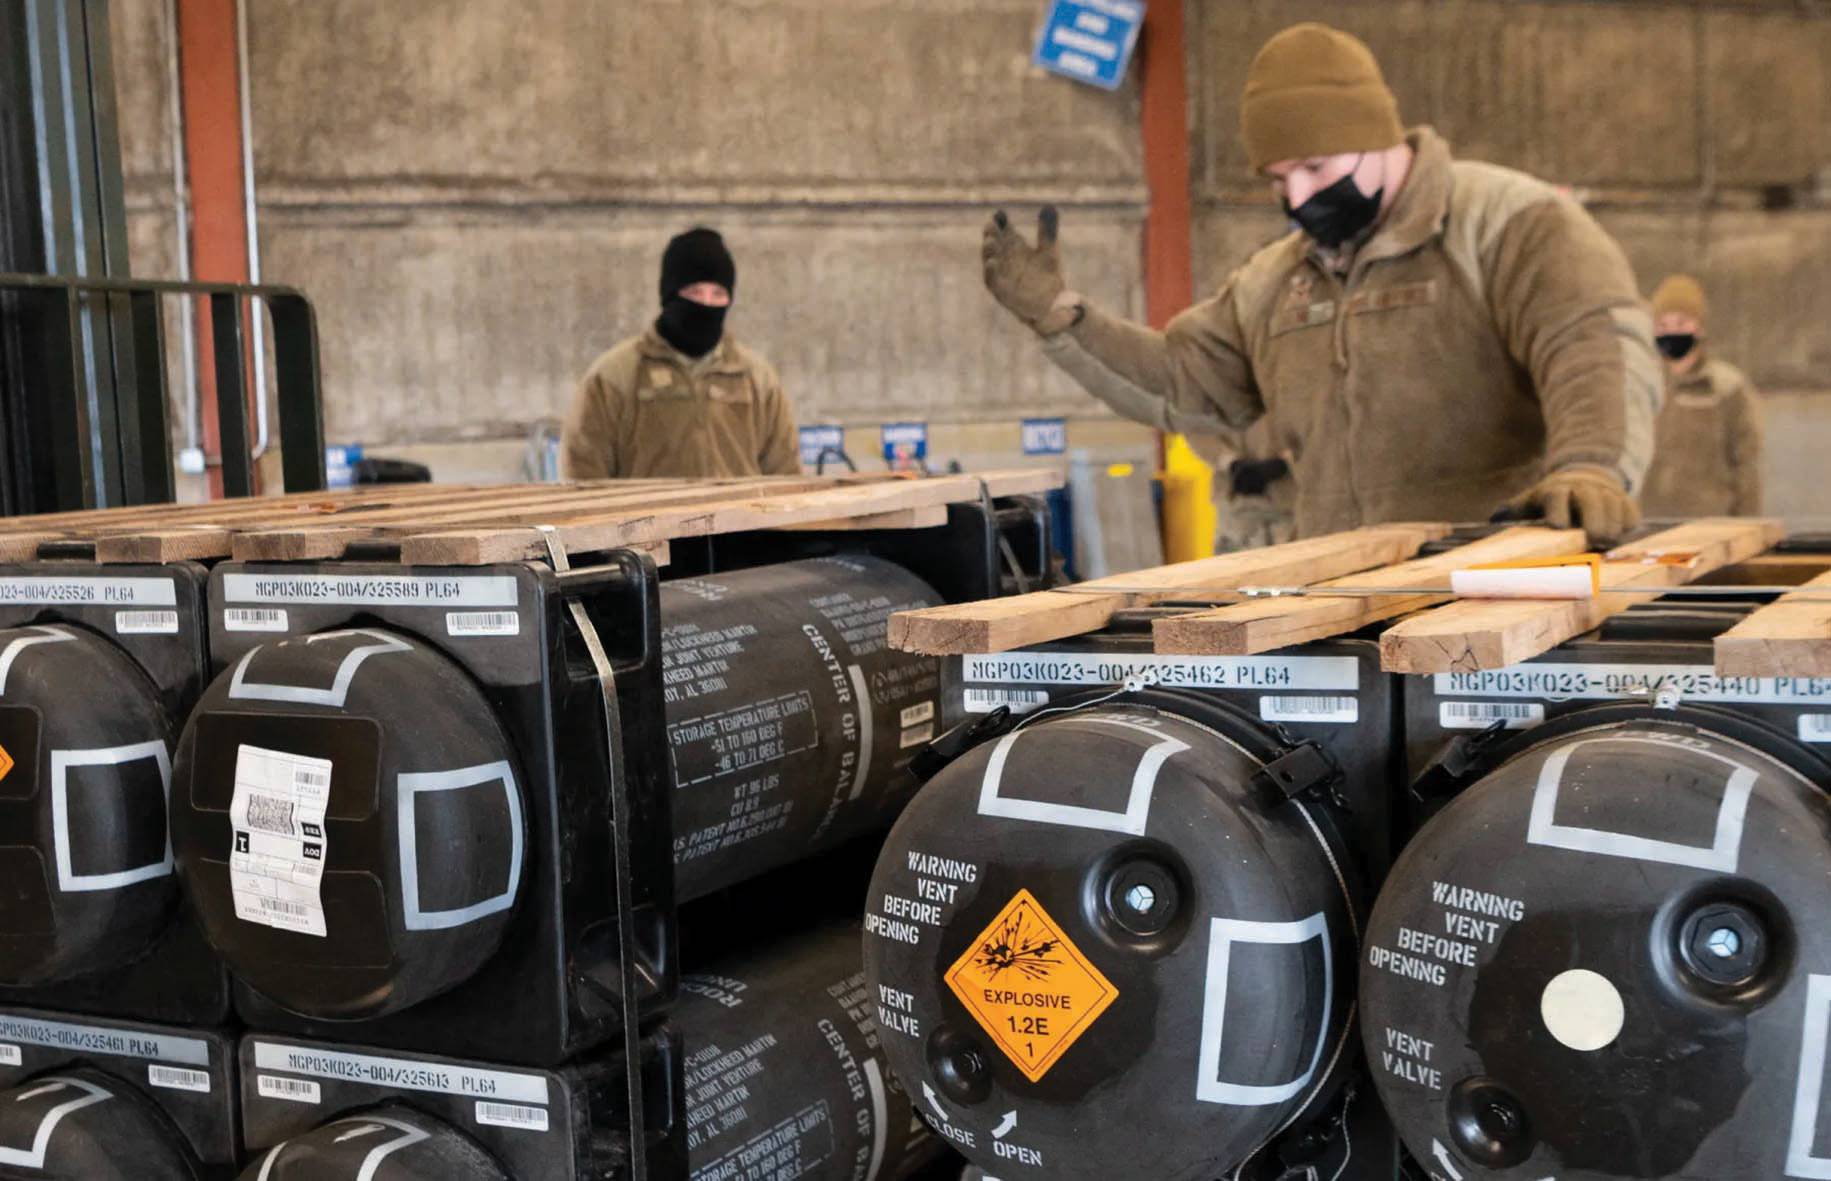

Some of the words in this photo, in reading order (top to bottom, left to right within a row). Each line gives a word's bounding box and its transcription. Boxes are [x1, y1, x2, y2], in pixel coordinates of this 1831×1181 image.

[105, 586, 134, 601] PL64
[425, 582, 460, 598] PL64
[802, 624, 851, 703] CENTER
[842, 713, 855, 741] OF
[1237, 666, 1291, 685] PL64
[673, 722, 717, 745] STORAGE
[718, 704, 782, 732] TEMPERATURE
[727, 734, 740, 750] TO
[734, 751, 746, 766] TO
[908, 850, 977, 884] WARNING
[917, 878, 958, 905] VENT
[1432, 881, 1525, 921] WARNING
[884, 894, 941, 926] BEFORE
[865, 913, 919, 945] OPENING
[1445, 912, 1499, 944] VENT
[1397, 927, 1478, 967] BEFORE
[1369, 945, 1446, 986] OPENING
[878, 983, 914, 1013] VENT
[983, 989, 1072, 1009] EXPLOSIVE
[878, 1005, 920, 1037] VALVE
[1007, 1015, 1050, 1036] 1.2E
[130, 1039, 159, 1056] PL64
[1025, 1042, 1034, 1058] 1
[1385, 1027, 1434, 1061] VENT
[462, 1076, 497, 1094] PL64
[817, 1018, 865, 1102] CENTER
[856, 1108, 870, 1136] OF
[1382, 1051, 1443, 1090] VALVE
[737, 1122, 800, 1168] TEMPERATURE
[925, 1113, 976, 1149] CLOSE
[993, 1141, 1043, 1167] OPEN
